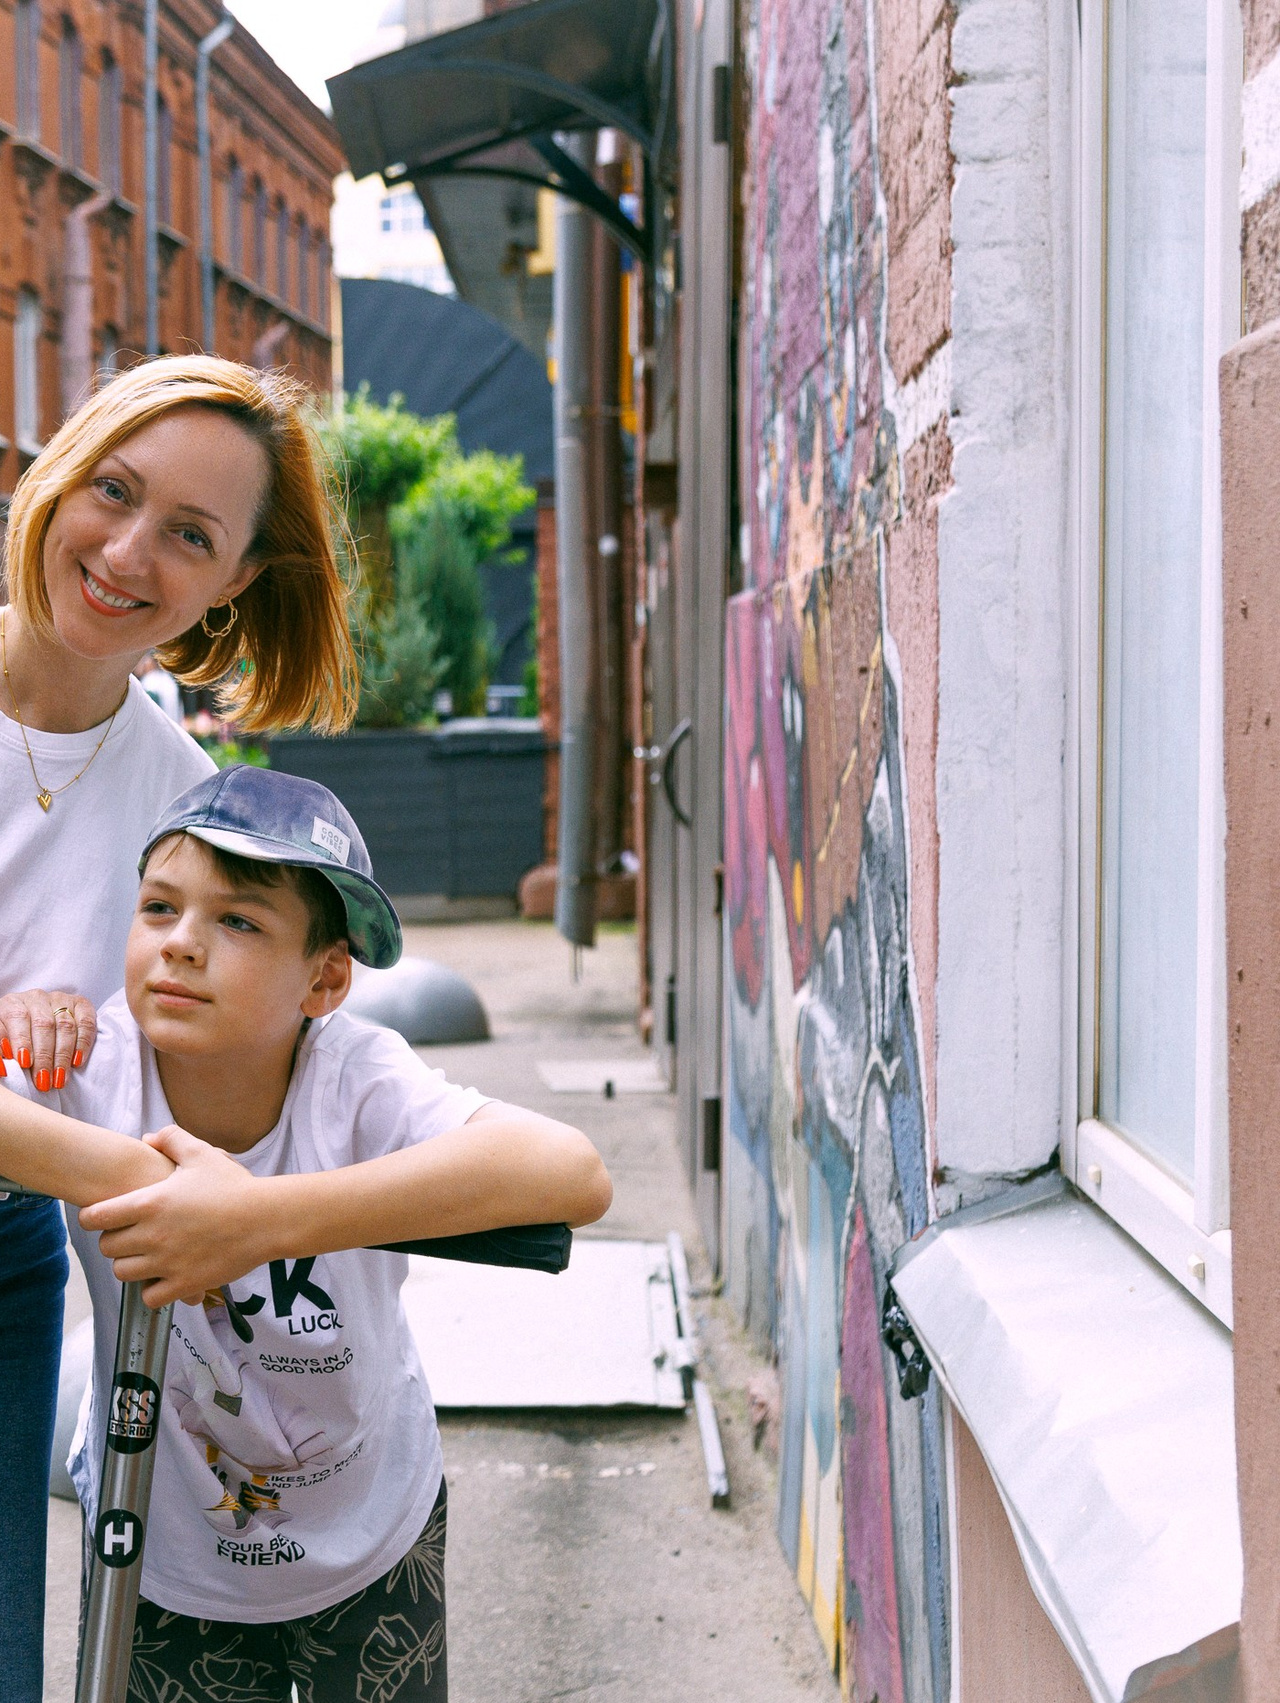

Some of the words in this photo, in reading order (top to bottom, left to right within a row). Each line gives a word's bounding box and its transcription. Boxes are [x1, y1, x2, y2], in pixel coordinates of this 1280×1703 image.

[322, 827, 343, 846] GOOD
[288, 1313, 344, 1335] LUCK
[259, 1353, 320, 1367] ALWAYS
[323, 1354, 339, 1365] IN
[343, 1346, 351, 1358] A
[261, 1362, 305, 1375] GOOD
[309, 1352, 354, 1375] MOOD
[128, 1424, 152, 1438] RIDE
[310, 1469, 331, 1479] TO
[104, 1521, 133, 1555] H
[217, 1536, 263, 1553] YOUR
[217, 1540, 305, 1566] FRIEND
